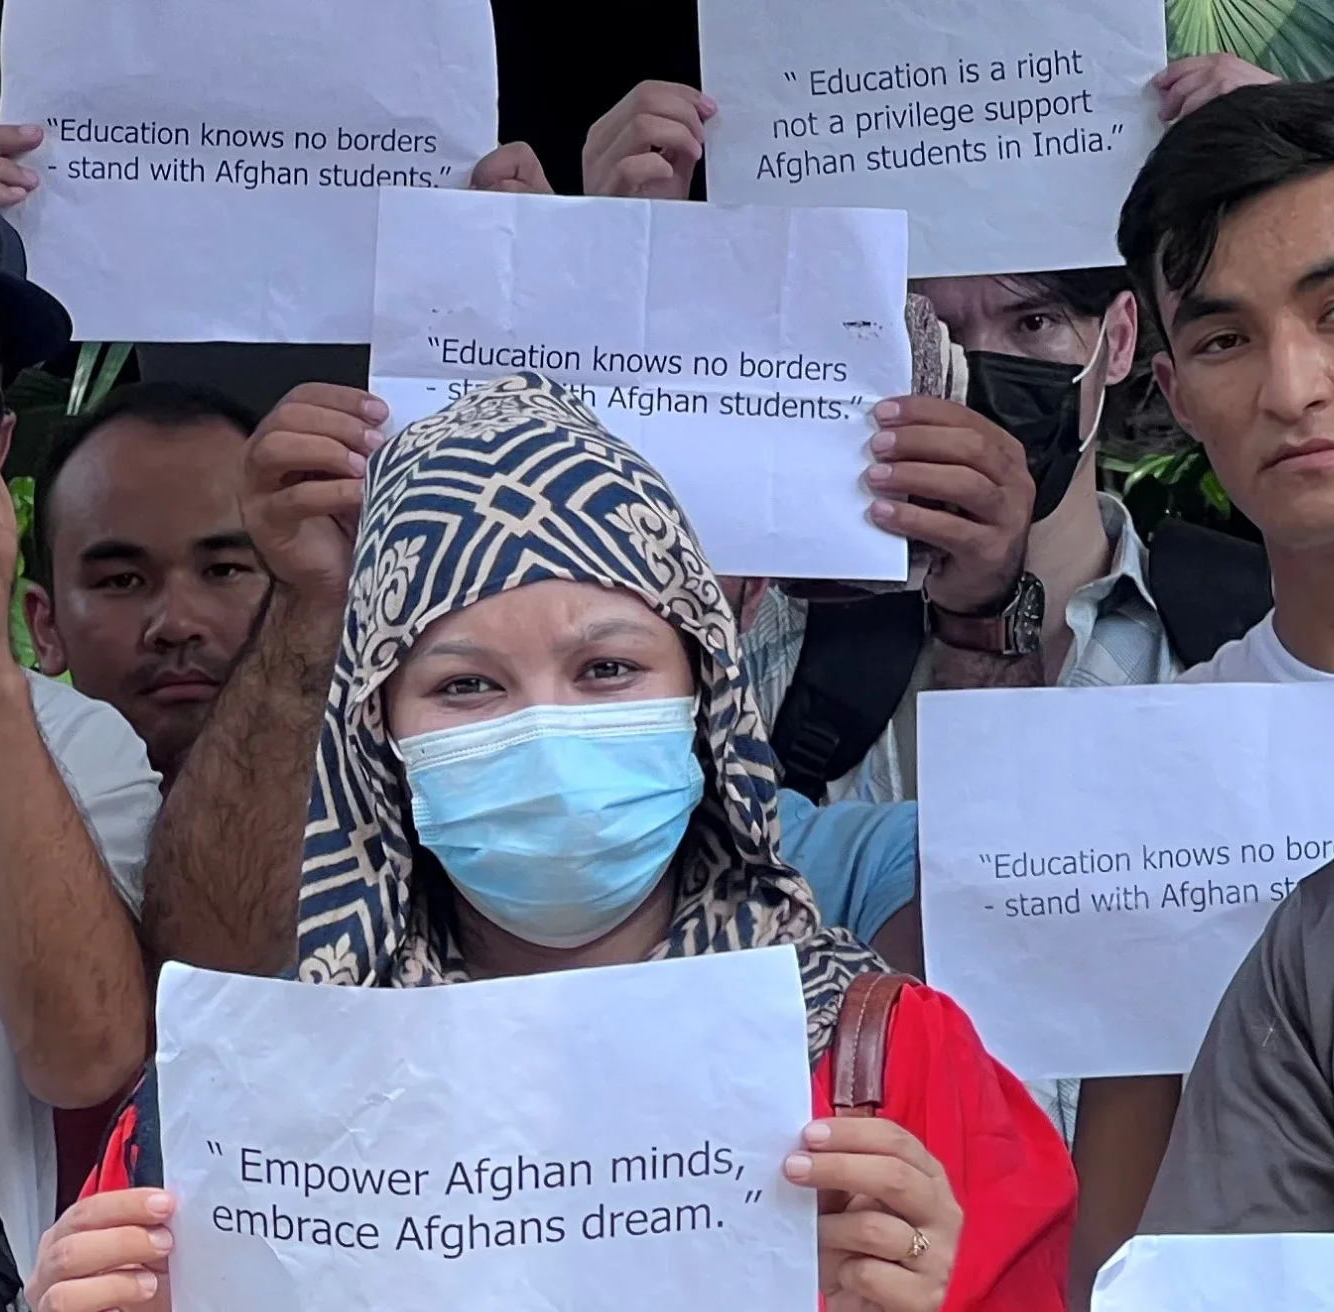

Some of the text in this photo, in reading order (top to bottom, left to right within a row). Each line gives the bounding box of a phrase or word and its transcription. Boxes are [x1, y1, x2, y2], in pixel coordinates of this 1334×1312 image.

[810, 62, 947, 96] Education
[958, 57, 980, 84] is
[990, 61, 1006, 82] a
[1017, 49, 1084, 84] right
[46, 117, 437, 154] “Education knows no borders
[772, 89, 1094, 139] not a privilege support
[67, 155, 139, 181] stand
[149, 157, 205, 183] with
[214, 158, 308, 191] Afghan
[756, 123, 1124, 184] Afghan students in India.”
[427, 336, 847, 383] “Education knows no borders
[607, 385, 708, 417] Afghan
[718, 391, 863, 421] students.”
[978, 848, 1131, 879] “Education
[1142, 844, 1231, 871] knows
[1241, 843, 1275, 864] no
[1005, 887, 1081, 918] stand
[1090, 884, 1150, 913] with
[1160, 879, 1259, 913] Afghan
[240, 1147, 430, 1199] Empower
[444, 1154, 592, 1202] Afghan
[611, 1139, 745, 1184] minds,
[212, 1203, 380, 1250] embrace
[394, 1213, 566, 1260] Afghans
[581, 1202, 724, 1241] dream.
